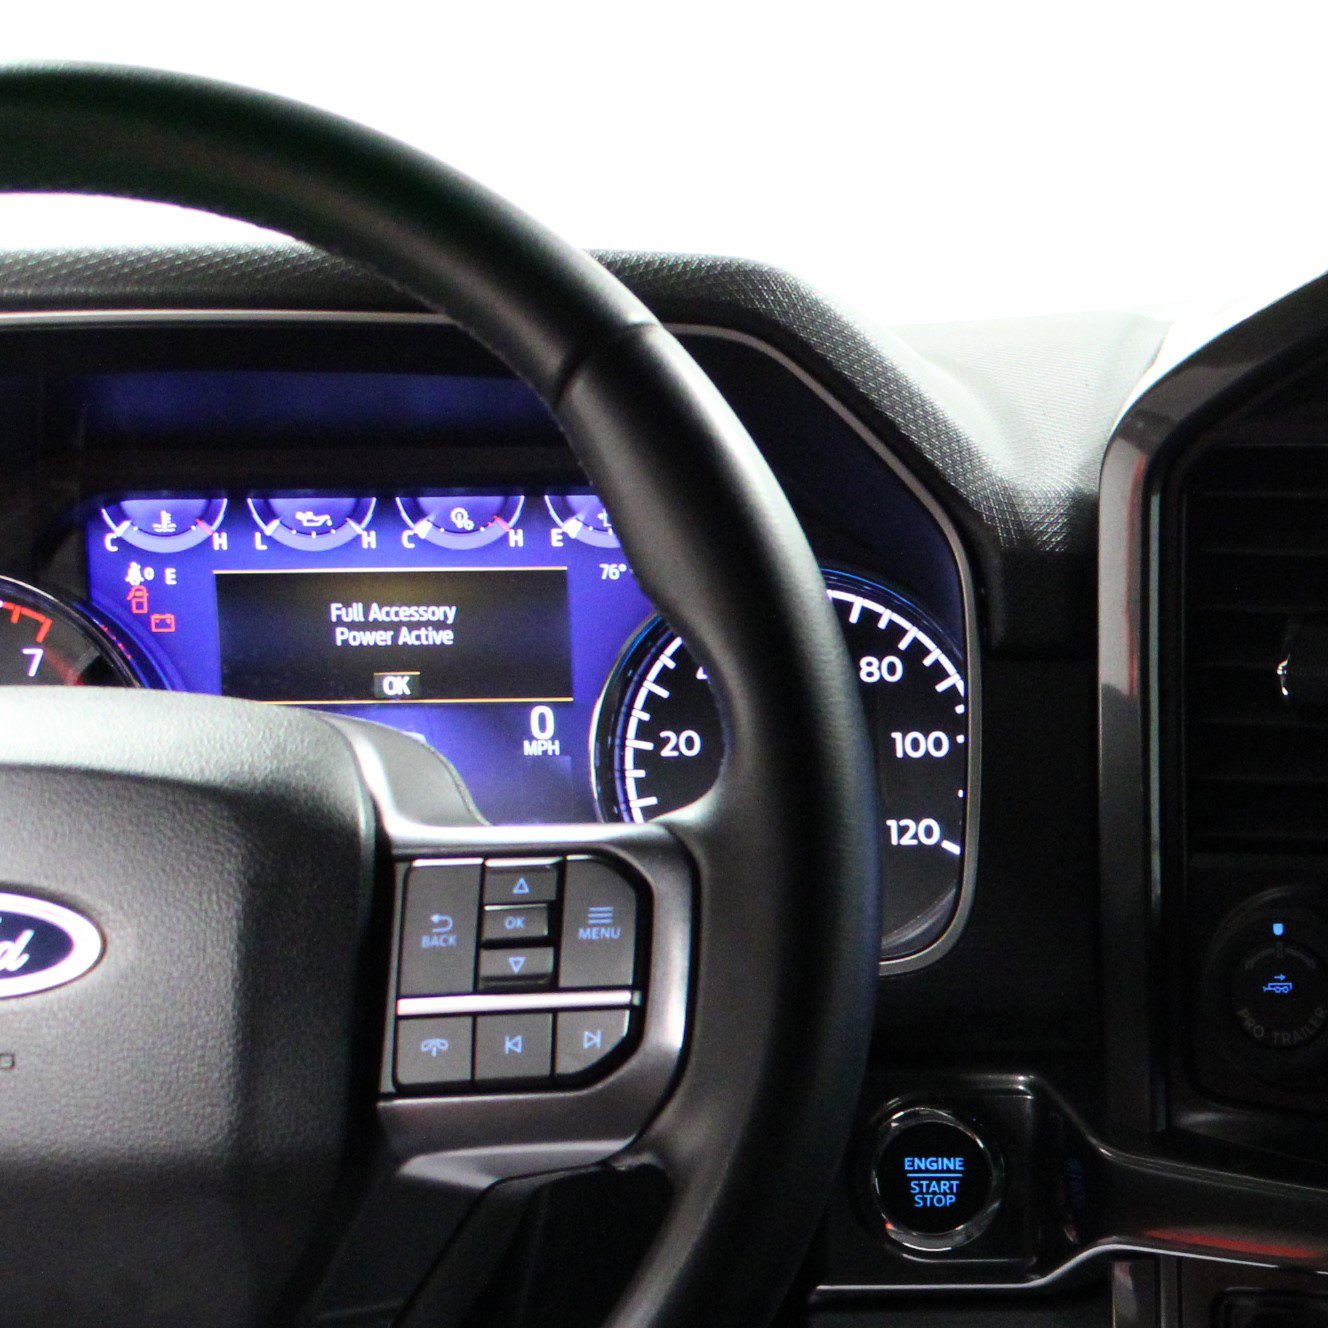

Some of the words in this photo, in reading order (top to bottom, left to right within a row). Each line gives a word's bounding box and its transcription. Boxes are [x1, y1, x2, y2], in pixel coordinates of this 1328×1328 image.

[104, 531, 118, 553] C
[213, 531, 228, 551] H
[254, 531, 268, 551] L
[362, 530, 377, 549] H
[401, 529, 416, 549] C
[509, 528, 524, 548] H
[550, 528, 564, 548] E
[330, 602, 365, 623] Full
[368, 602, 457, 628] Accessory
[335, 626, 395, 647] Power
[397, 625, 455, 646] Active
[22, 647, 44, 677] 7
[859, 655, 904, 683] 80
[382, 675, 411, 696] OK
[529, 705, 555, 740] 0
[523, 739, 561, 756] MPH
[659, 729, 702, 757] 20
[890, 730, 950, 759] 100
[885, 817, 941, 847] 120
[504, 916, 525, 930] OK
[578, 926, 621, 940] MENU
[421, 934, 457, 949] BACK
[904, 1156, 965, 1171] ENGINE
[910, 1180, 960, 1194] START
[914, 1194, 956, 1208] STOP
